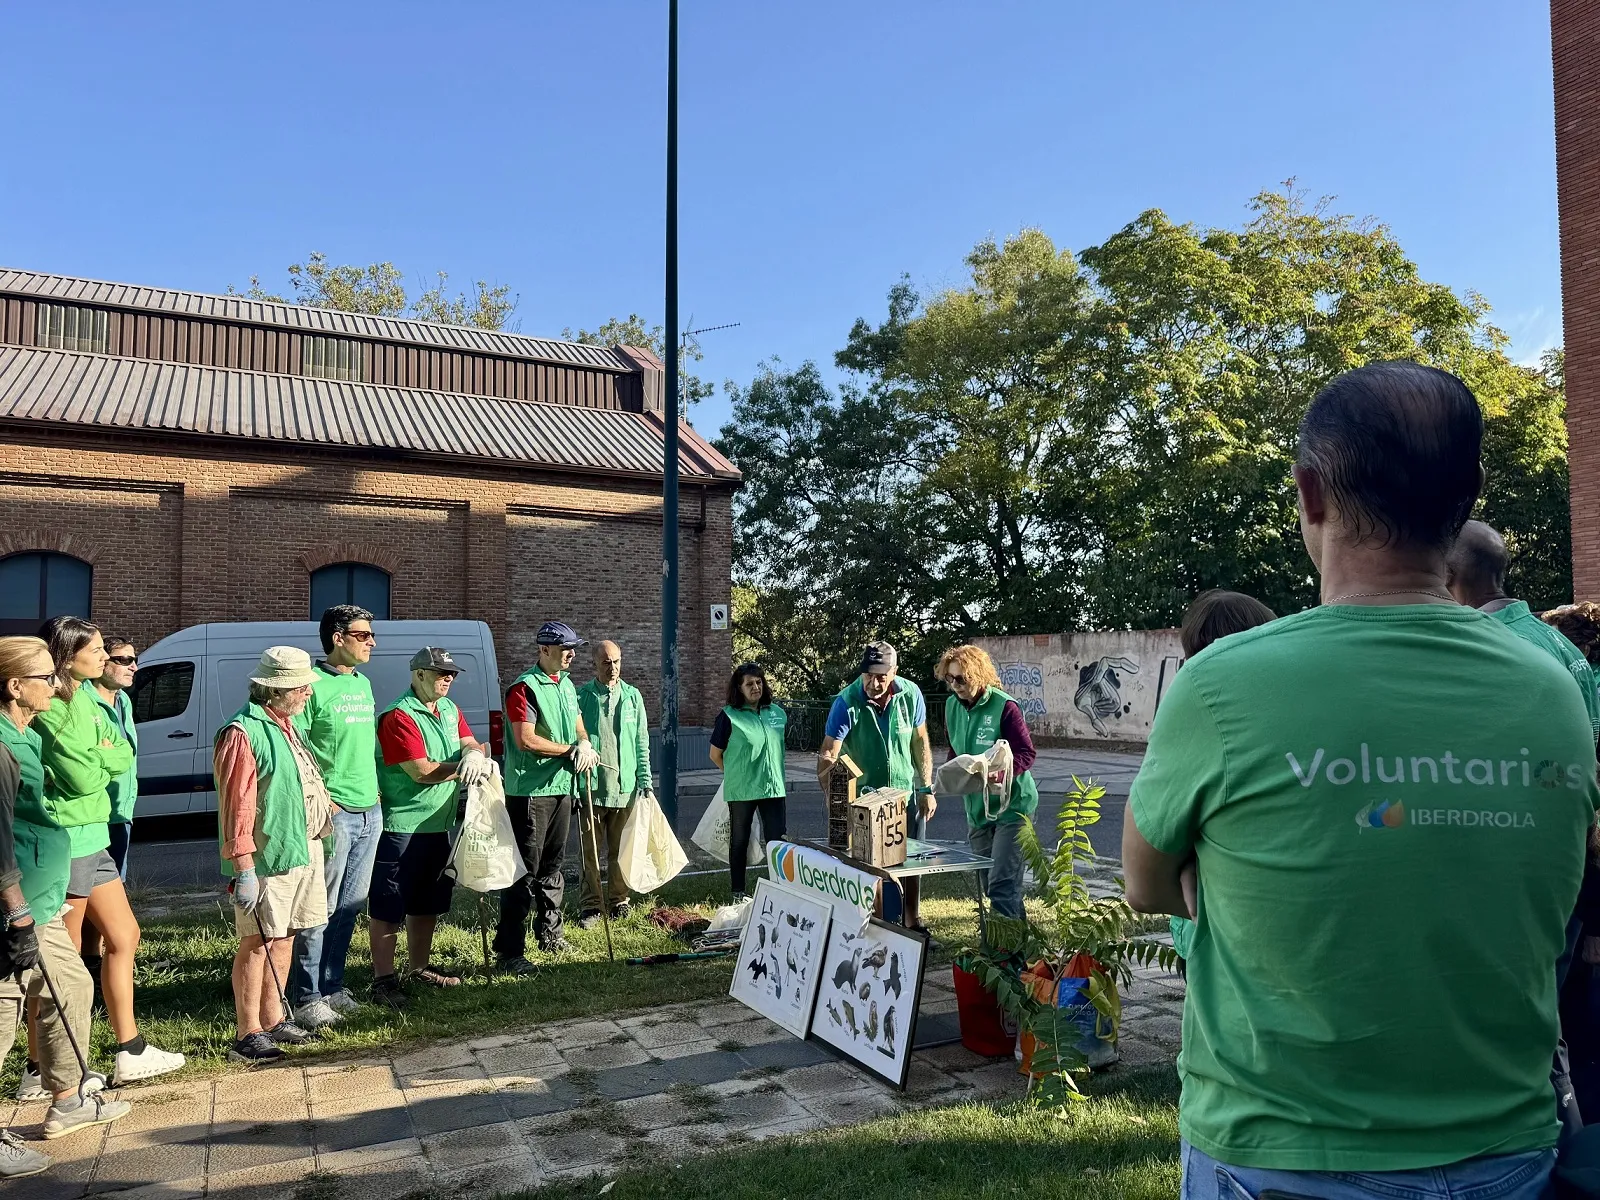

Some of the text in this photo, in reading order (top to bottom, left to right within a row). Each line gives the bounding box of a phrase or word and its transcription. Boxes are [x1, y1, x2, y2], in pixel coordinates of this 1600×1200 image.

[1285, 742, 1583, 790] Voluntarios
[884, 820, 904, 848] 55
[1410, 808, 1536, 829] IBERDROLA
[797, 853, 875, 912] Iberdrola
